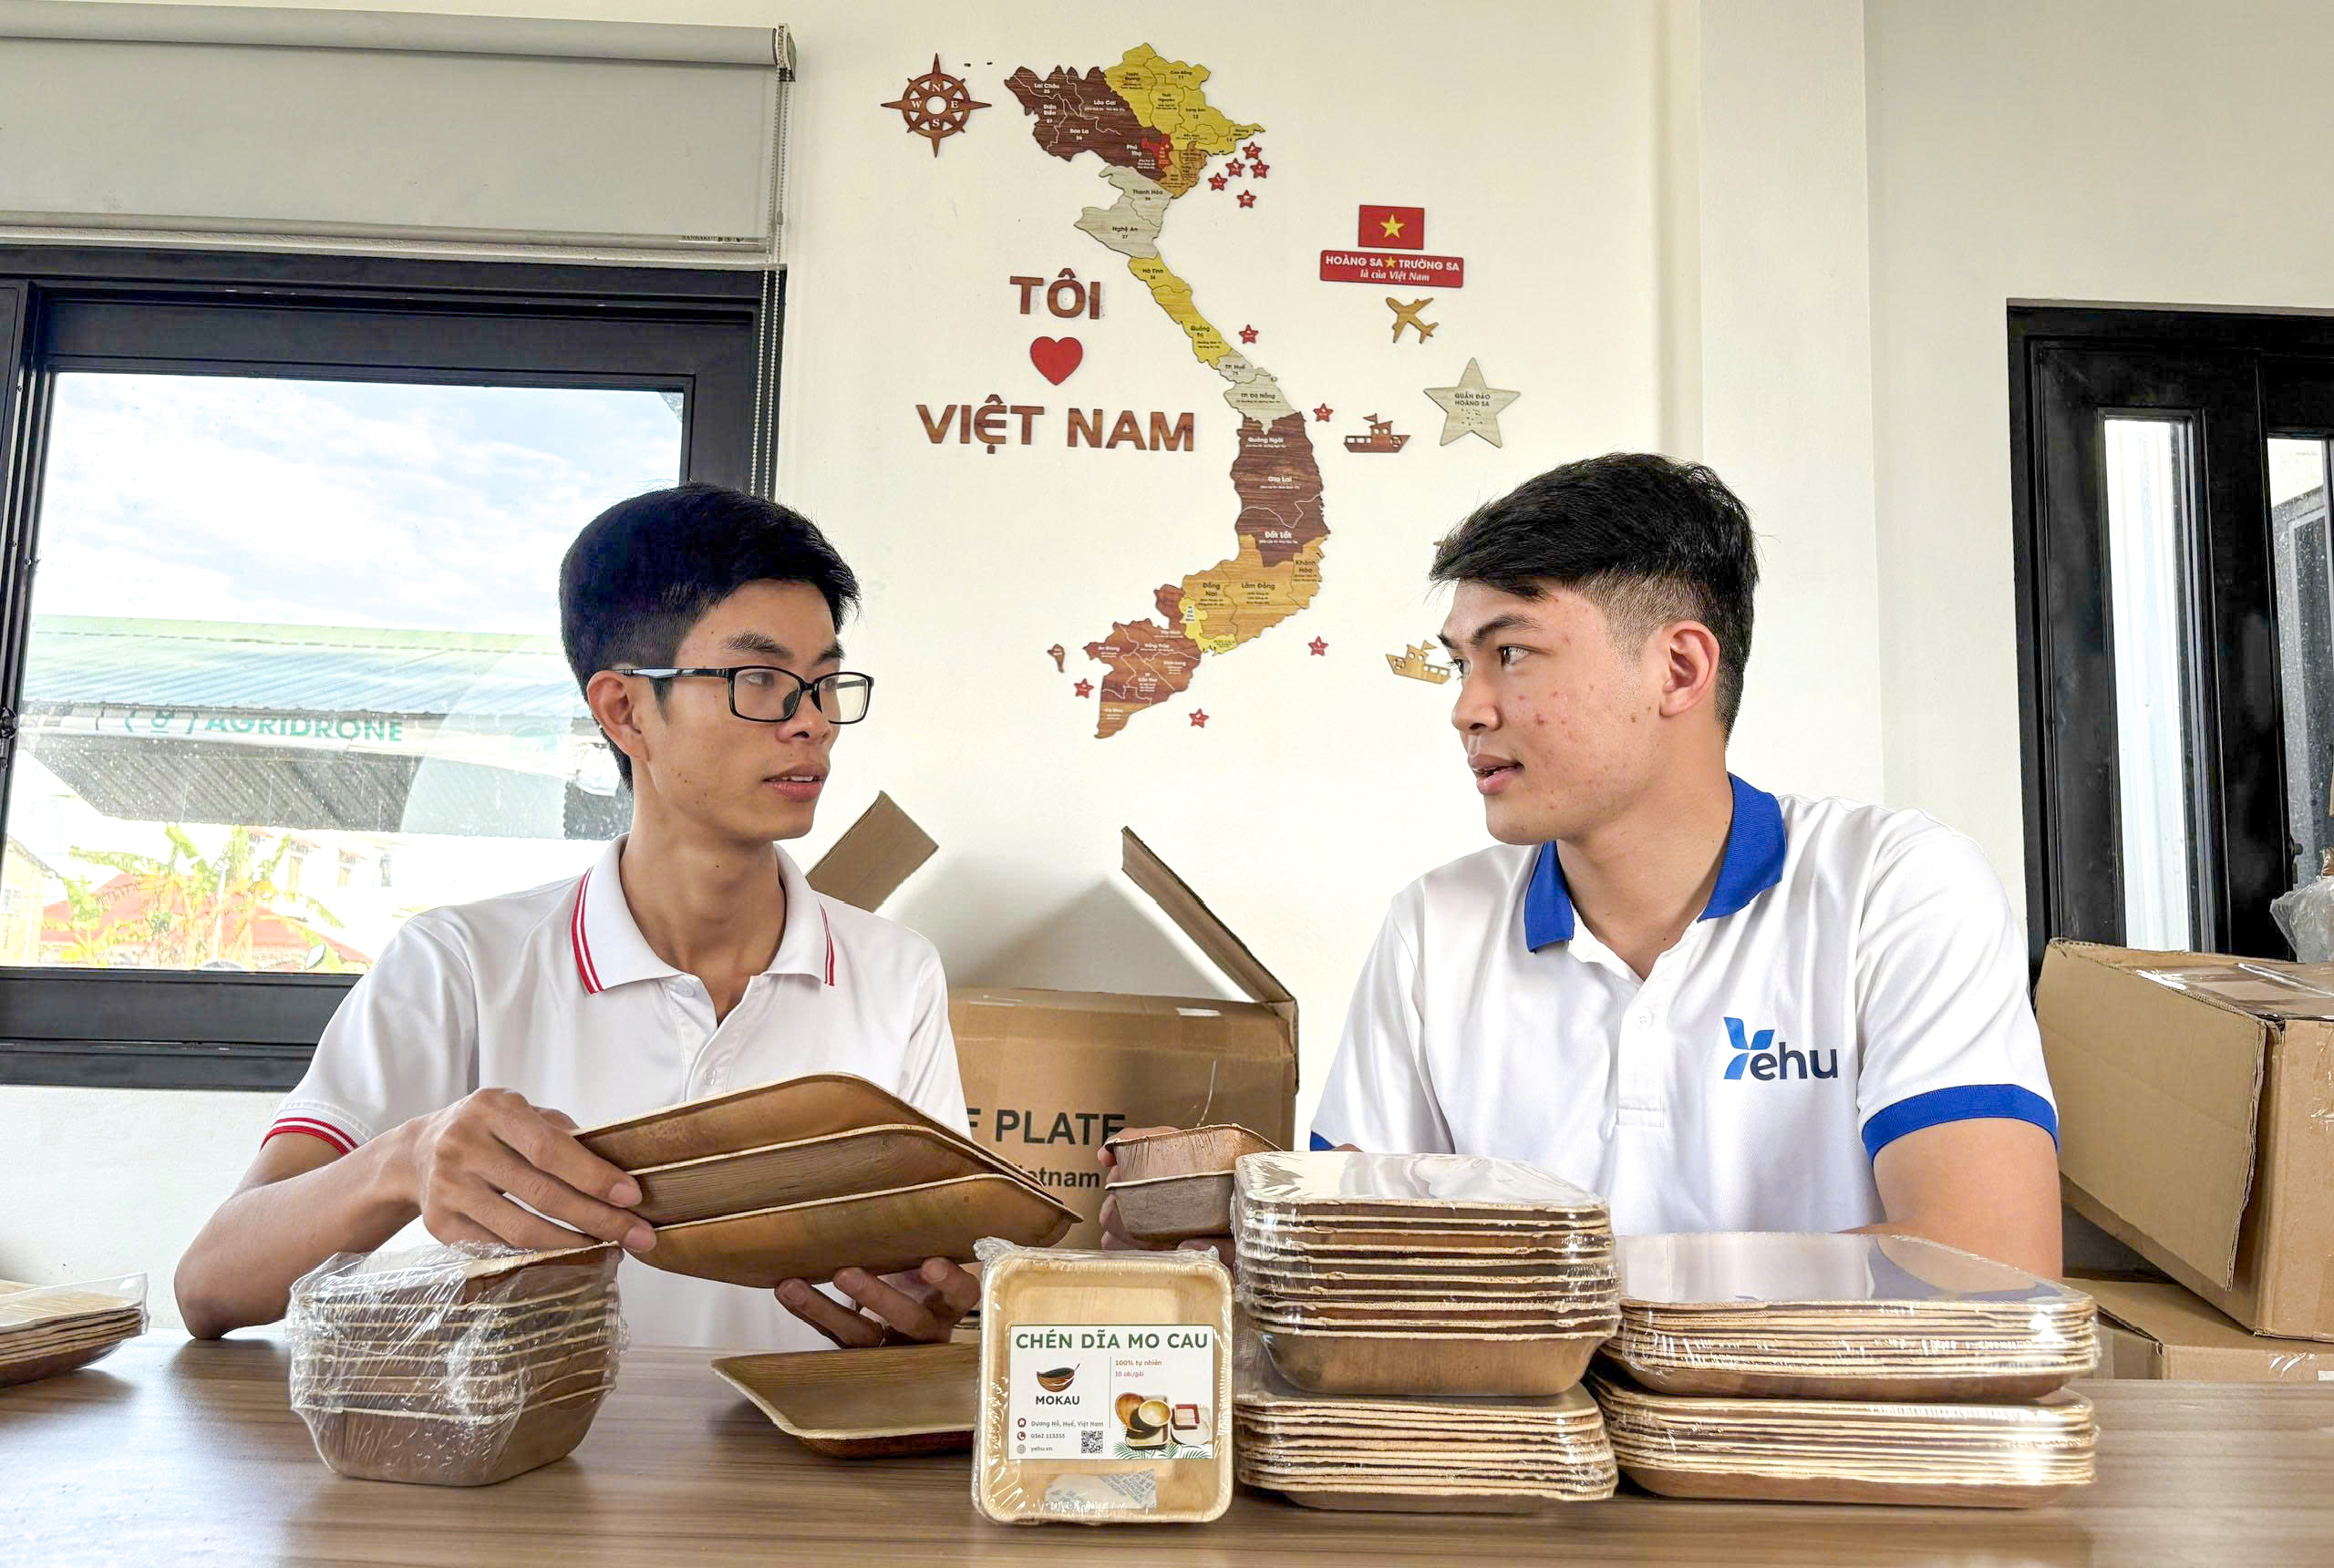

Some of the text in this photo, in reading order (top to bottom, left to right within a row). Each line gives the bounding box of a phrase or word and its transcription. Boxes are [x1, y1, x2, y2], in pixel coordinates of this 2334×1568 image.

[932, 84, 941, 92] N
[951, 100, 959, 108] E
[933, 119, 940, 127] S
[1326, 254, 1460, 272] HOÀNG SA TRƯỜNG SA
[1360, 269, 1430, 282] là của Việt Nam
[1010, 267, 1100, 319] TÔI
[915, 394, 1194, 454] VIỆT NAM
[1016, 1328, 1208, 1349] CHÉN DĨA MO CAU
[1036, 1396, 1080, 1406] MOKAU
[1030, 1444, 1053, 1452] yehu.vn
